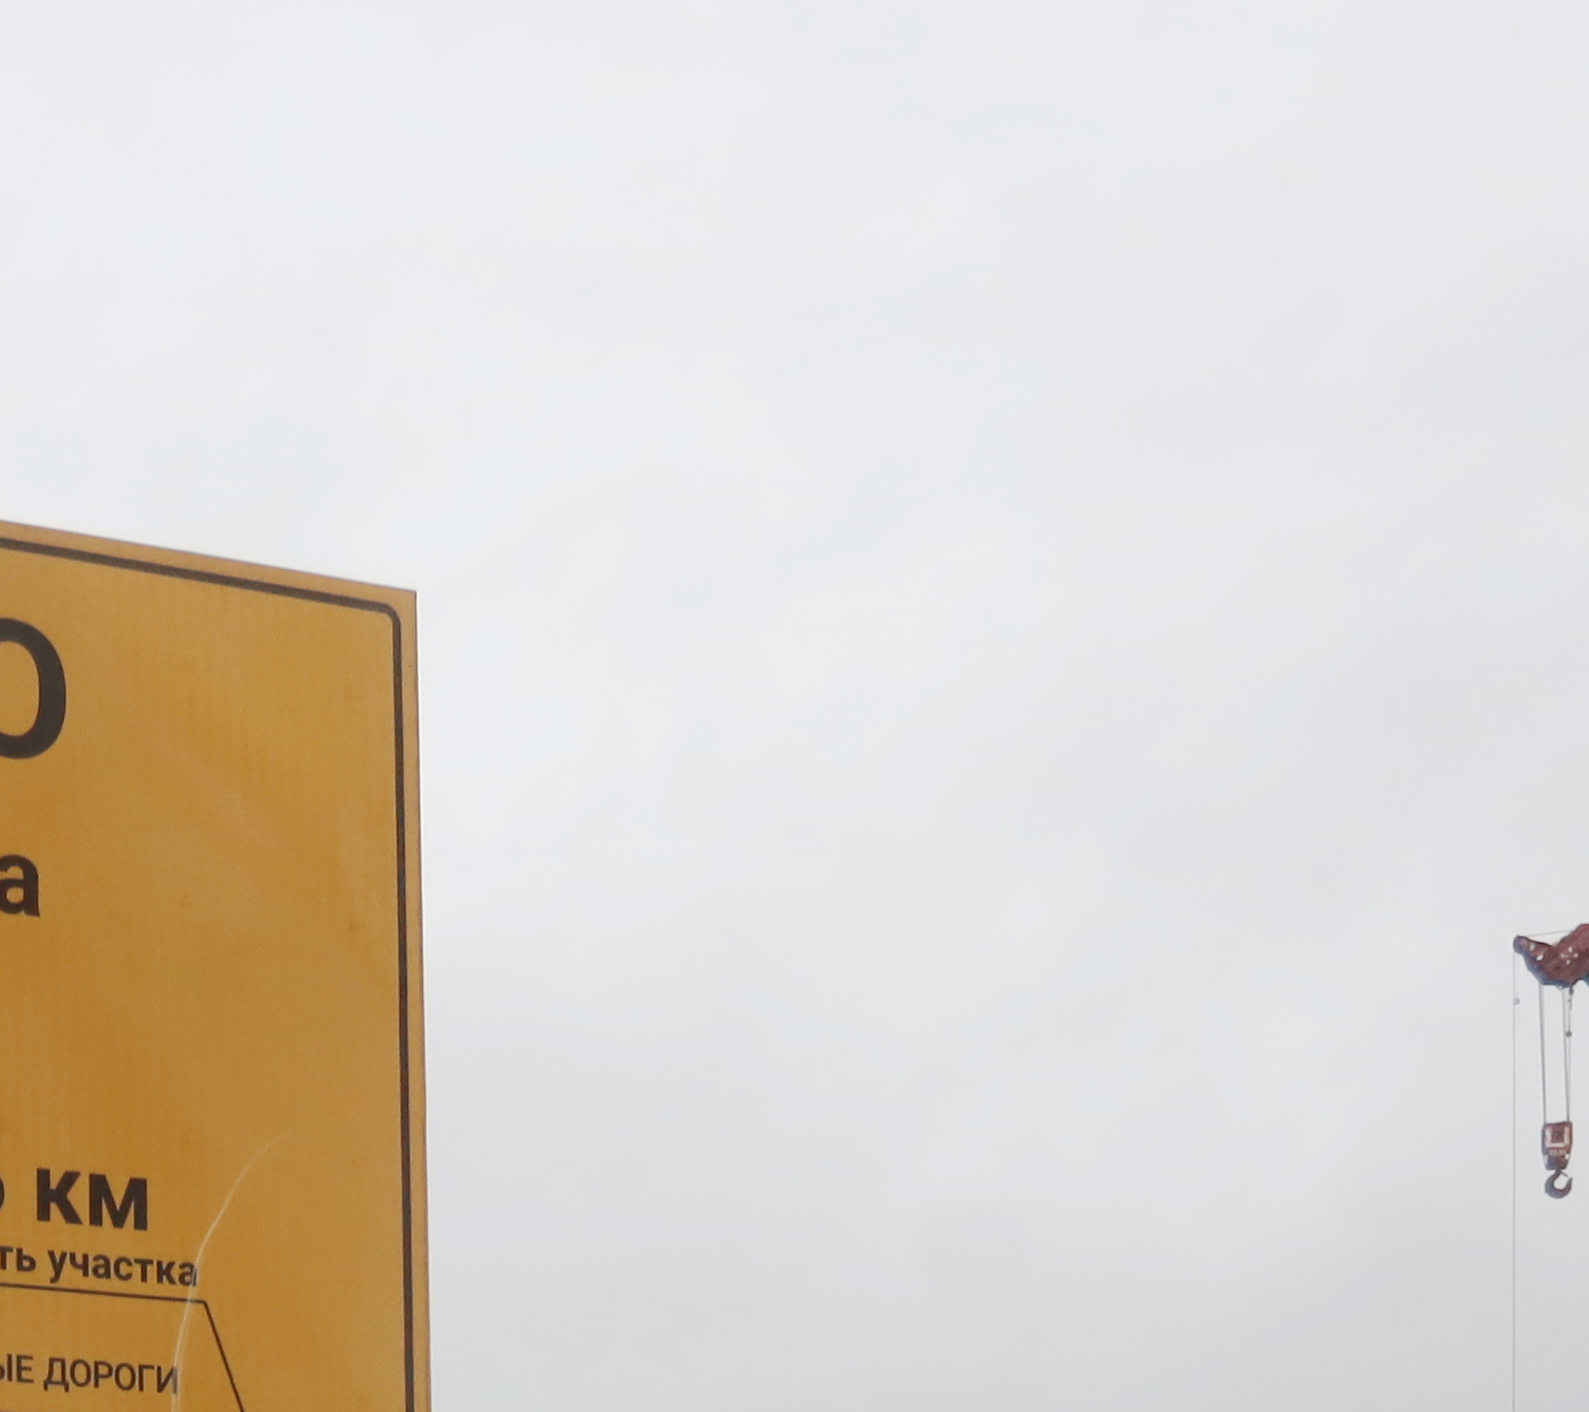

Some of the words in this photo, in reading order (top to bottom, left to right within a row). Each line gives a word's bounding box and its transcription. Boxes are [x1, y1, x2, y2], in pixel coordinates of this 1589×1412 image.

[37, 1168, 147, 1231] км
[48, 1251, 197, 1286] участка
[44, 1358, 178, 1393] ДОРОГИ
